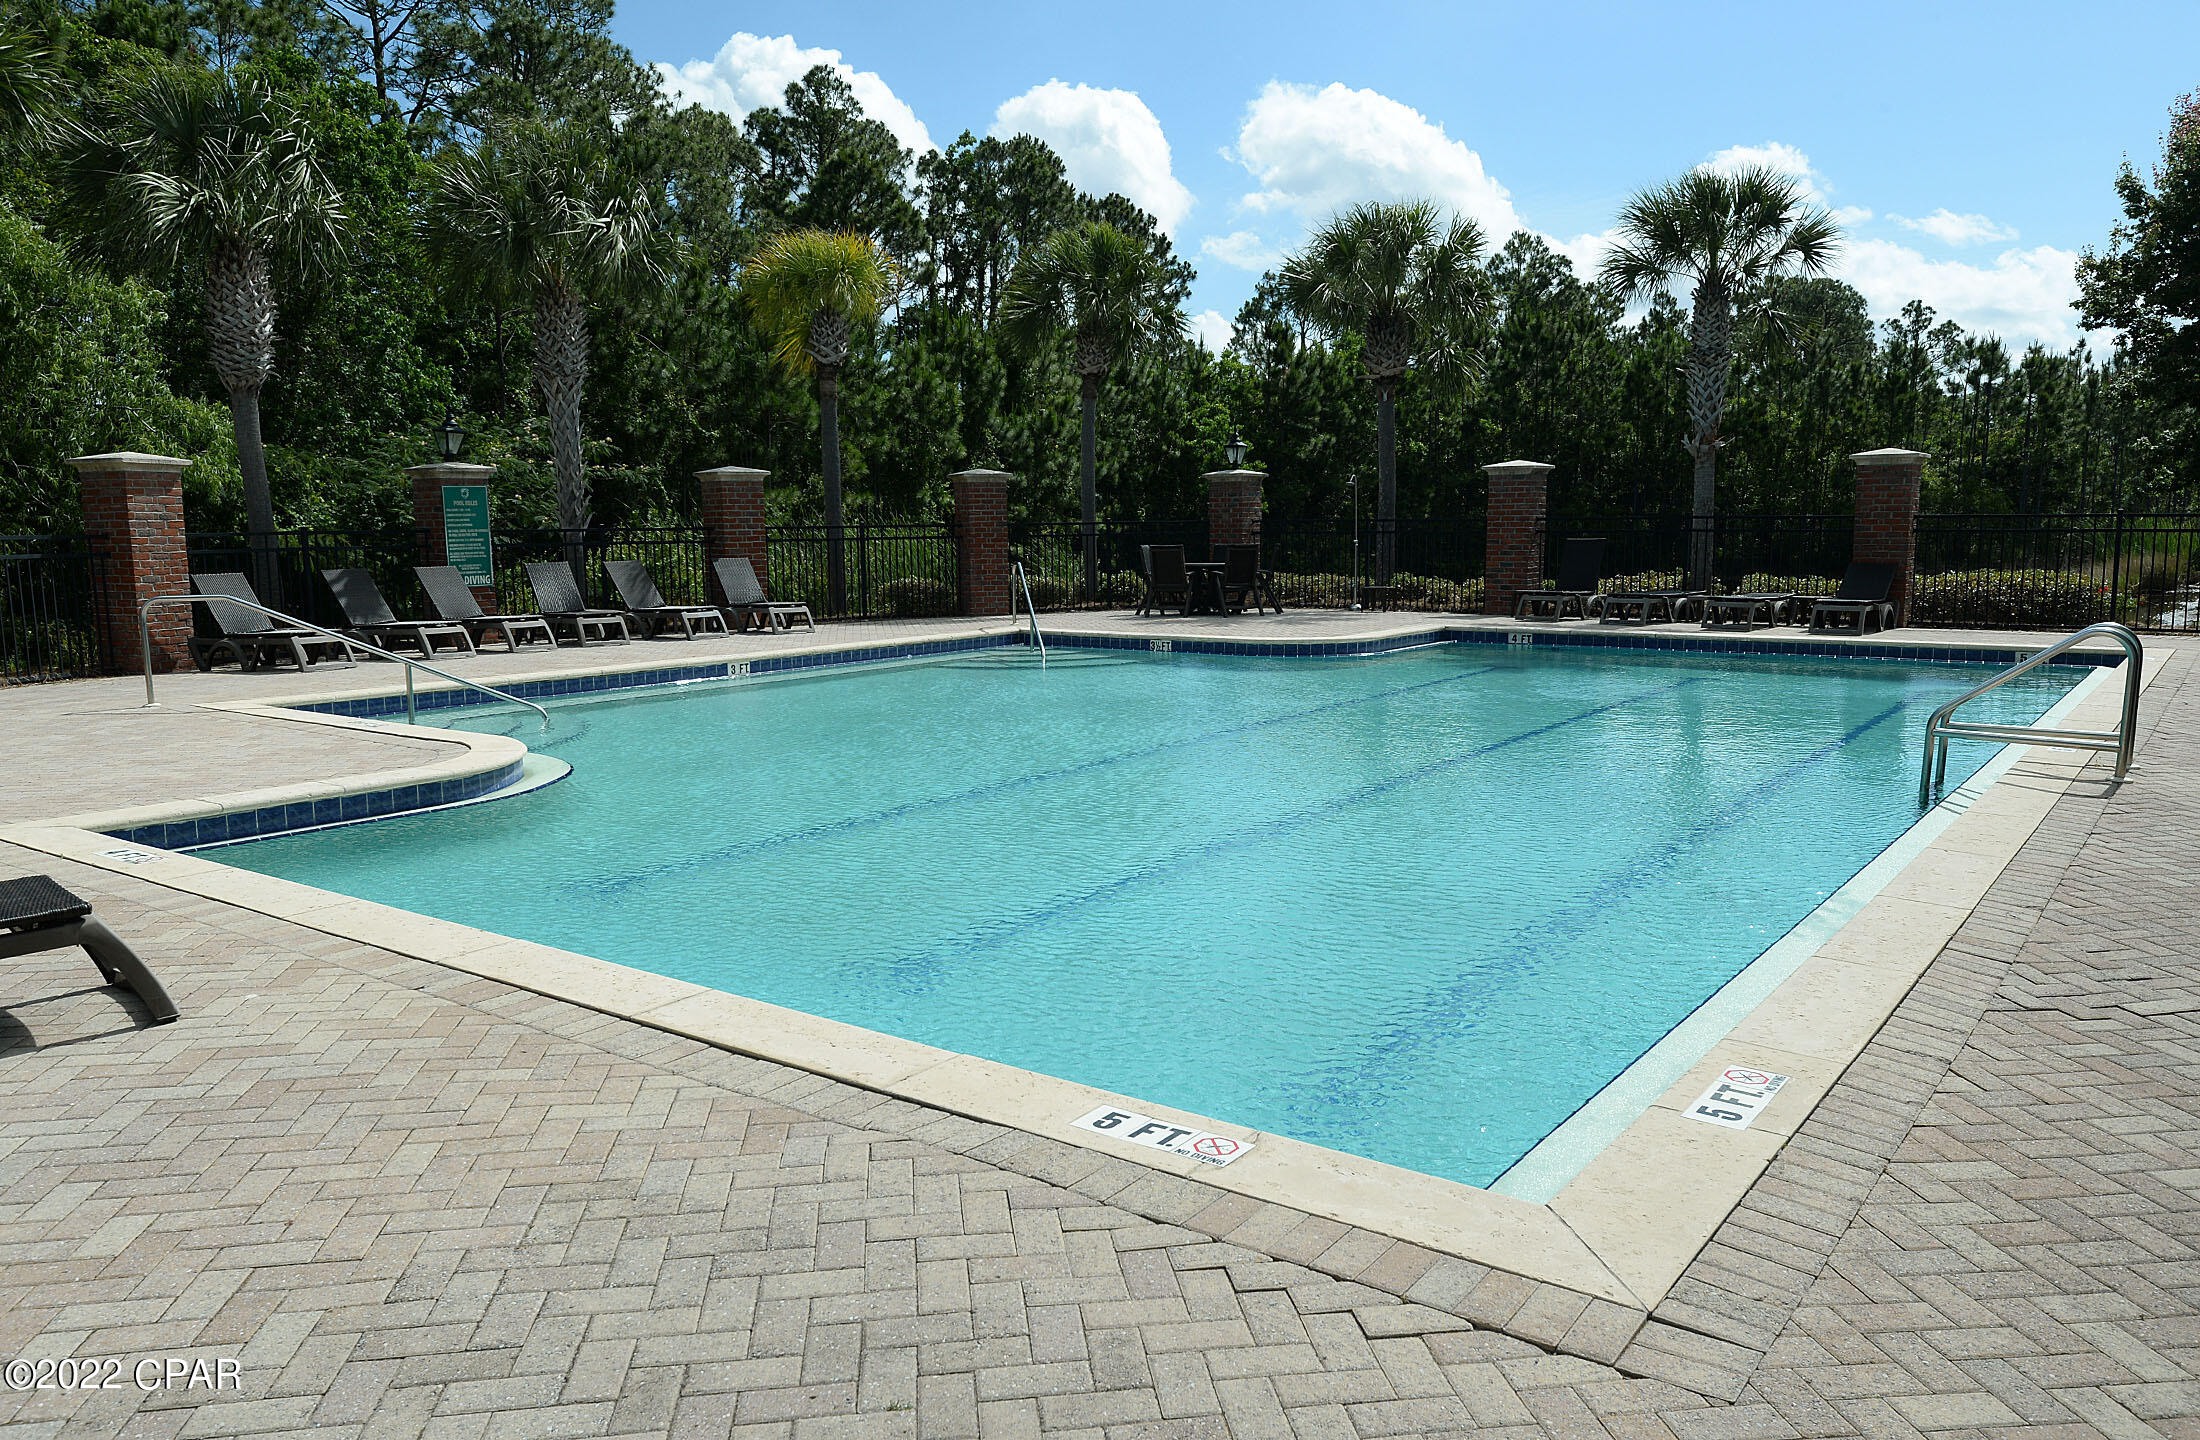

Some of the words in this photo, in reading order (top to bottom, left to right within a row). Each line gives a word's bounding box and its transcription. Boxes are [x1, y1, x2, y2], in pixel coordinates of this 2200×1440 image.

[464, 575, 491, 585] DIVING
[730, 664, 736, 675] 3
[1092, 1112, 1131, 1129] 5
[1695, 1105, 1743, 1121] 5
[1174, 1148, 1190, 1156] NO
[1190, 1152, 1226, 1165] DIVING
